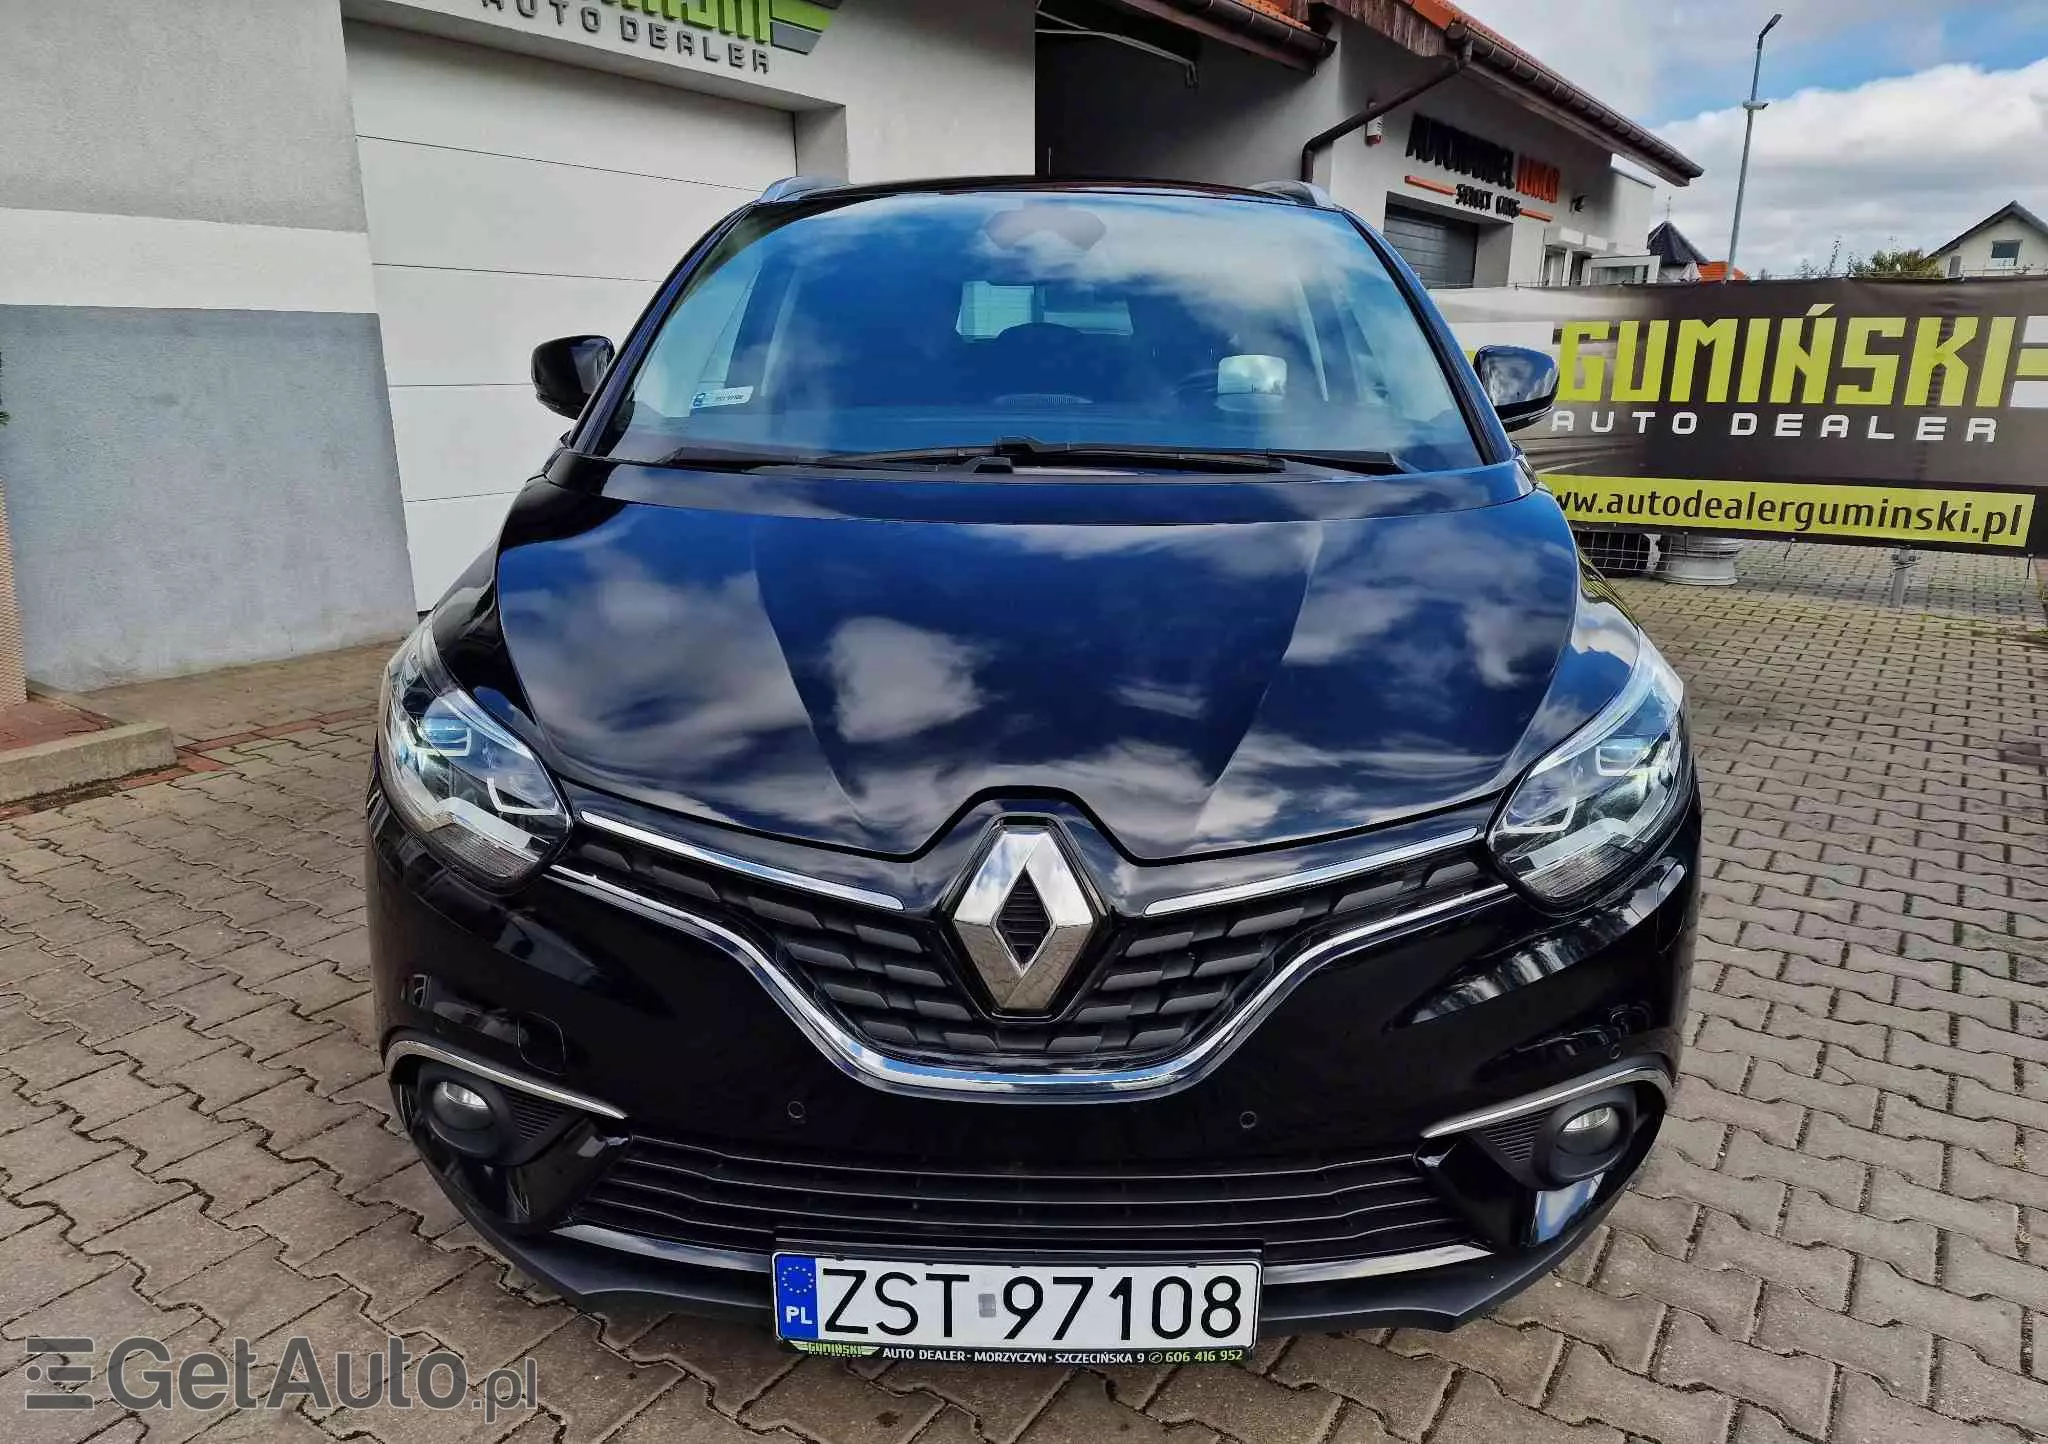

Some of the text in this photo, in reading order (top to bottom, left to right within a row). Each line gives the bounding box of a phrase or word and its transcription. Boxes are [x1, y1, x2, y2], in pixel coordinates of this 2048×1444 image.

[620, 15, 769, 74] DEALER
[1558, 303, 2017, 408] GUMIŃSKI
[1551, 411, 1998, 443] AUTO DEALER
[786, 1306, 813, 1325] PL
[823, 1268, 1242, 1341] ZST 97108
[883, 1348, 915, 1360] AUTO
[974, 1351, 1047, 1362] MORZYCZYN
[1055, 1351, 1133, 1364] SZCZECIŃSKA
[1137, 1353, 1145, 1363] 9
[1165, 1351, 1191, 1362] 606
[1194, 1350, 1216, 1362] 416
[1220, 1350, 1243, 1361] 952
